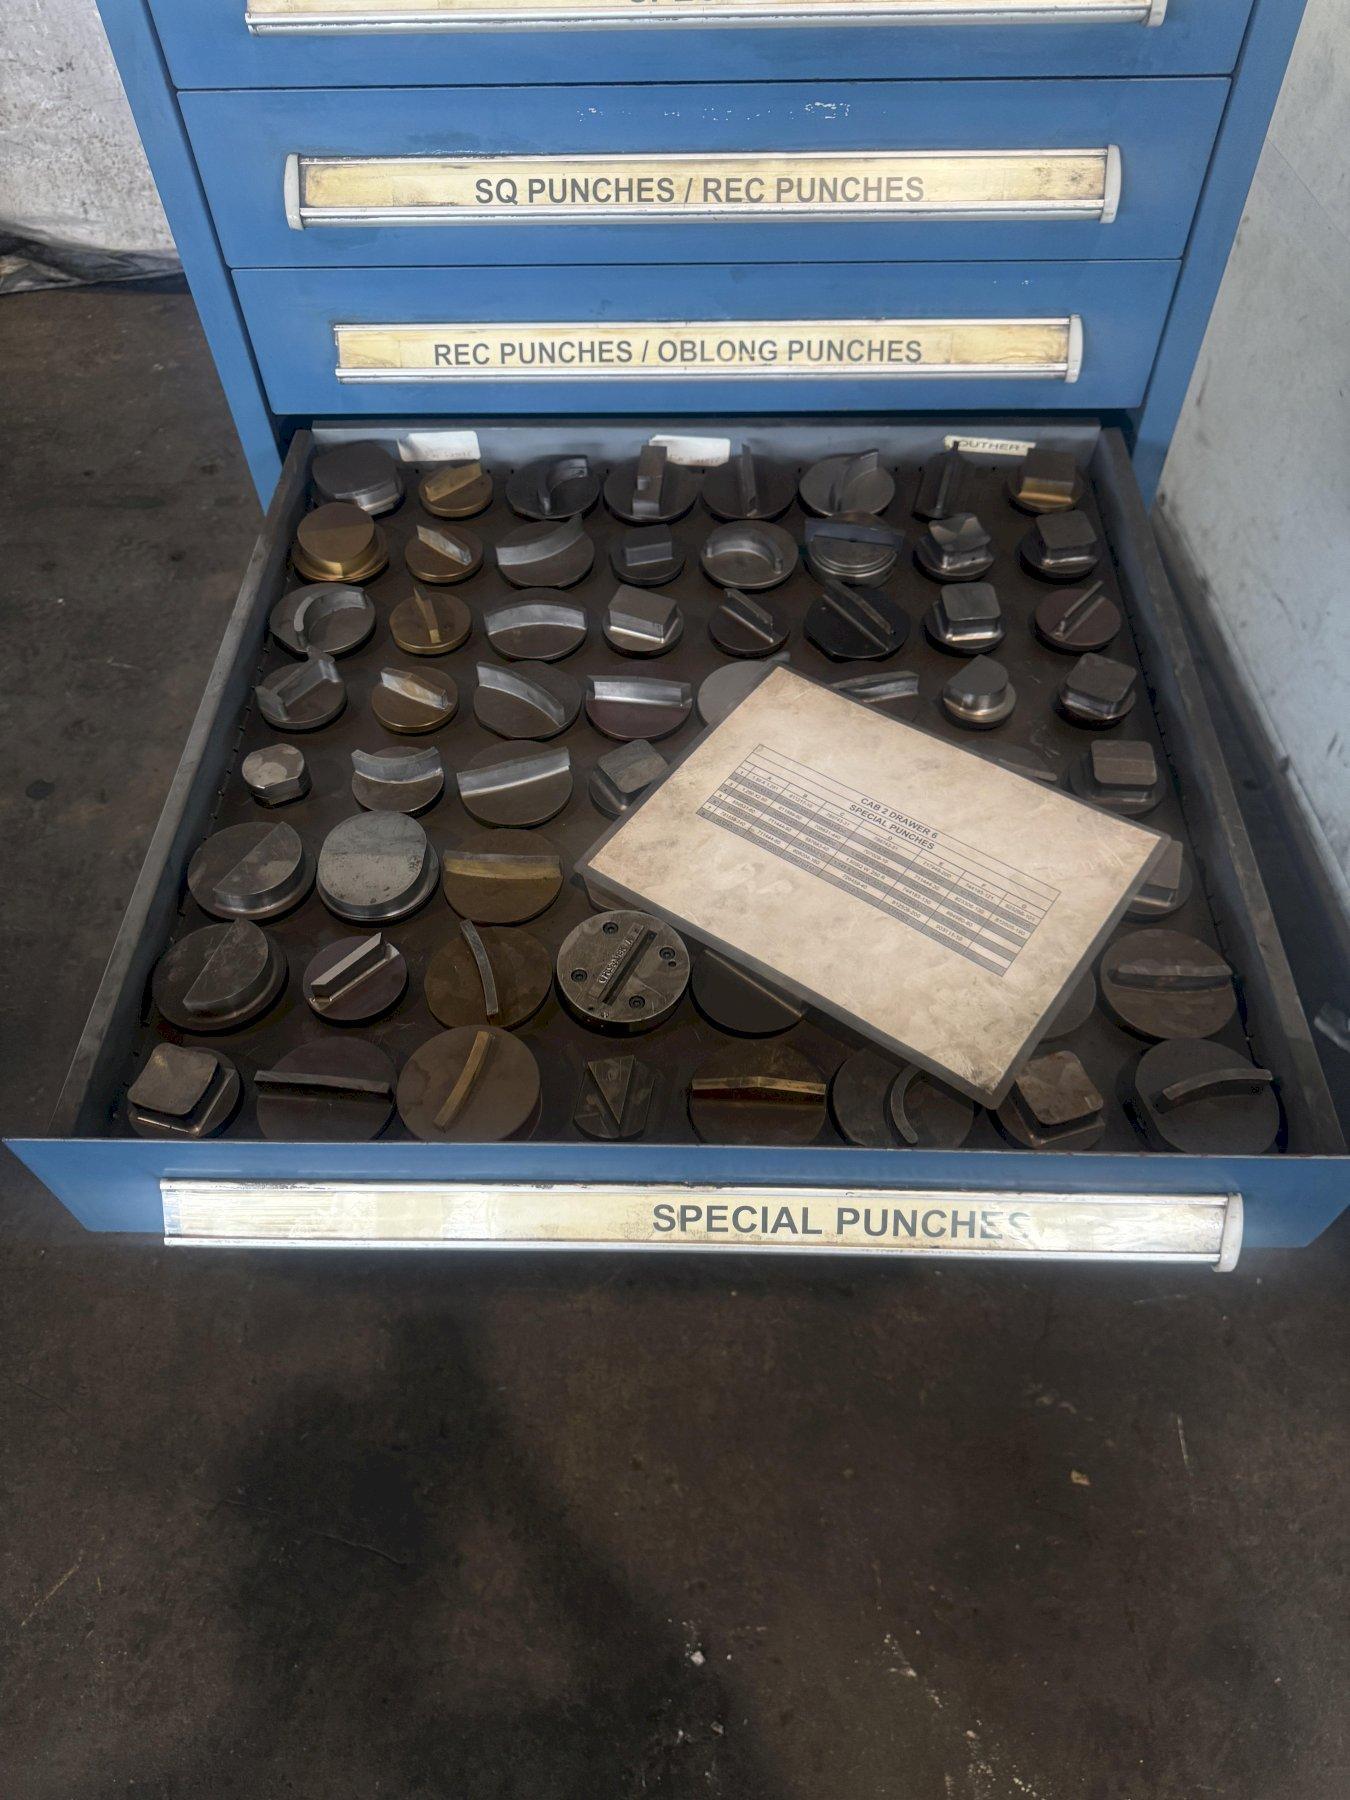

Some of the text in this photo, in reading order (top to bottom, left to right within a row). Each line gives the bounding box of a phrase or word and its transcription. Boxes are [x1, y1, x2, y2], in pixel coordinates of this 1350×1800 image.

[475, 176, 924, 205] SQ PUNCHES / REC PUNCHES
[434, 340, 922, 365] REC PUNCHES / OBLONG PUNCHES
[849, 804, 888, 828] SPECIAL
[889, 824, 935, 850] PUNCHES
[860, 798, 881, 811] CAB
[888, 811, 931, 836] DRAWER
[652, 1203, 823, 1235] SPECIAL
